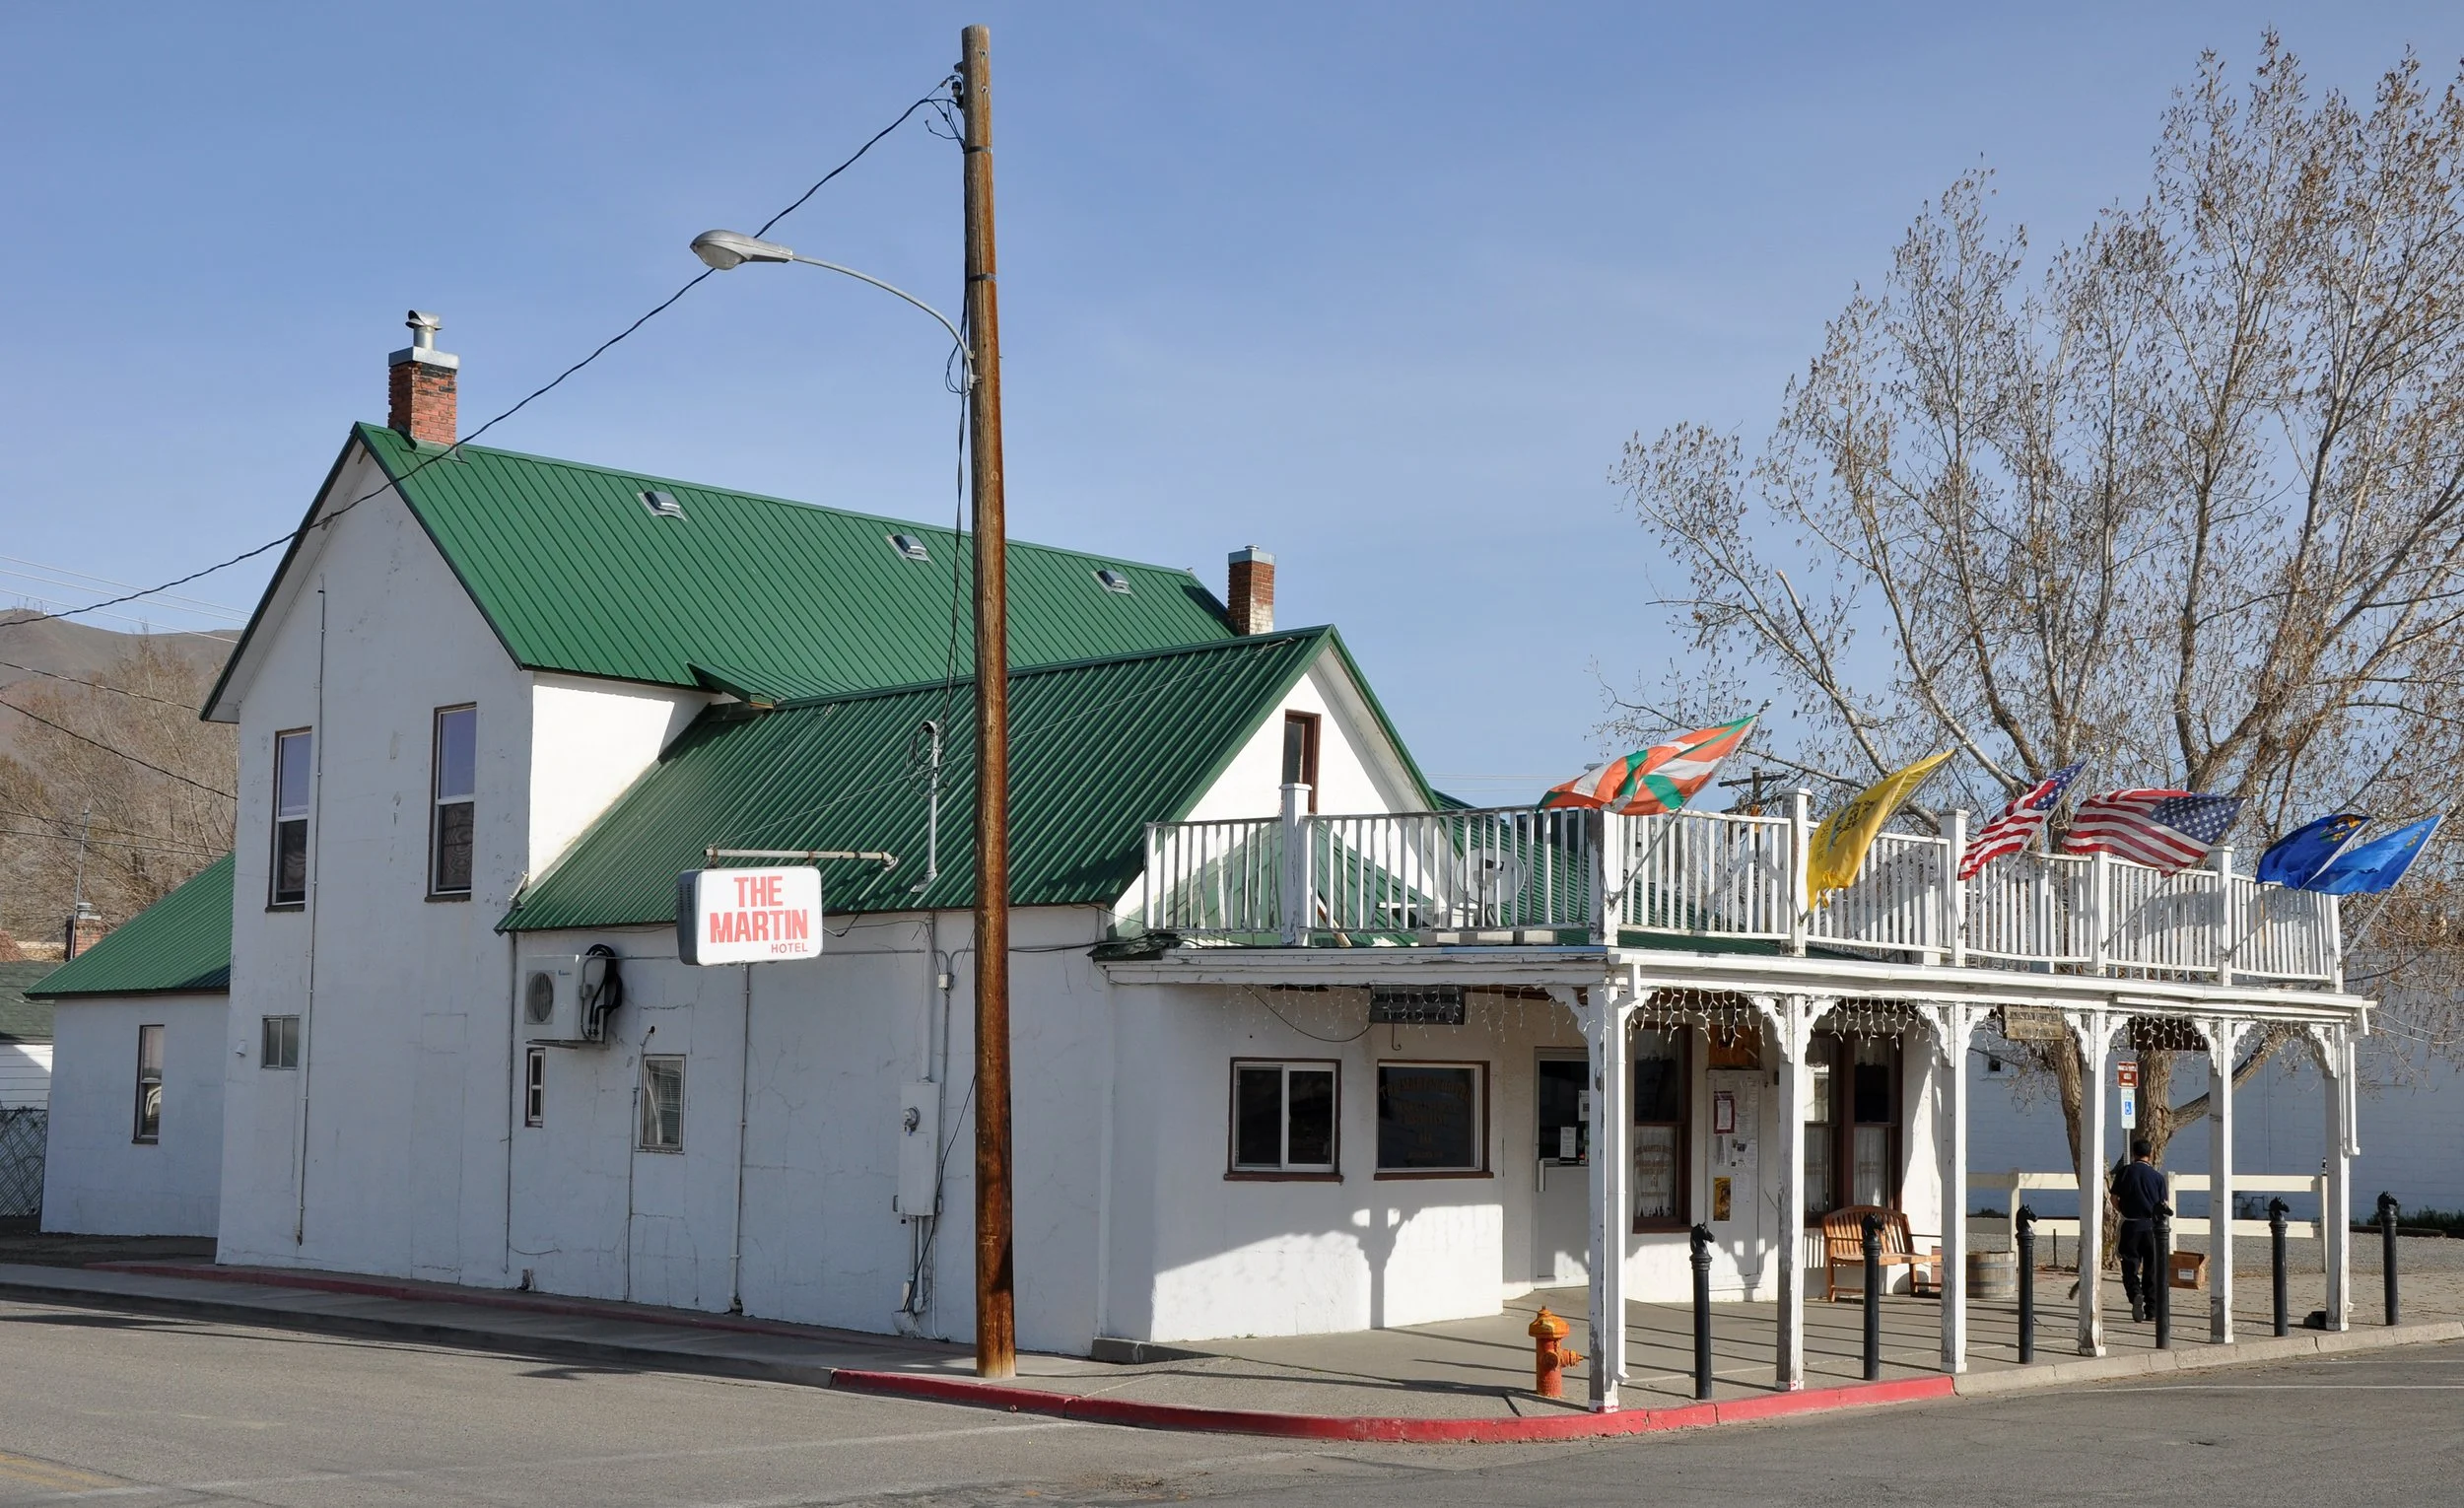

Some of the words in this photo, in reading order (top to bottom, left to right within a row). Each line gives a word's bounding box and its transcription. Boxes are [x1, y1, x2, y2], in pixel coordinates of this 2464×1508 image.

[733, 875, 784, 908] THE
[710, 909, 808, 943] MARTIN
[771, 942, 808, 953] HOTEL
